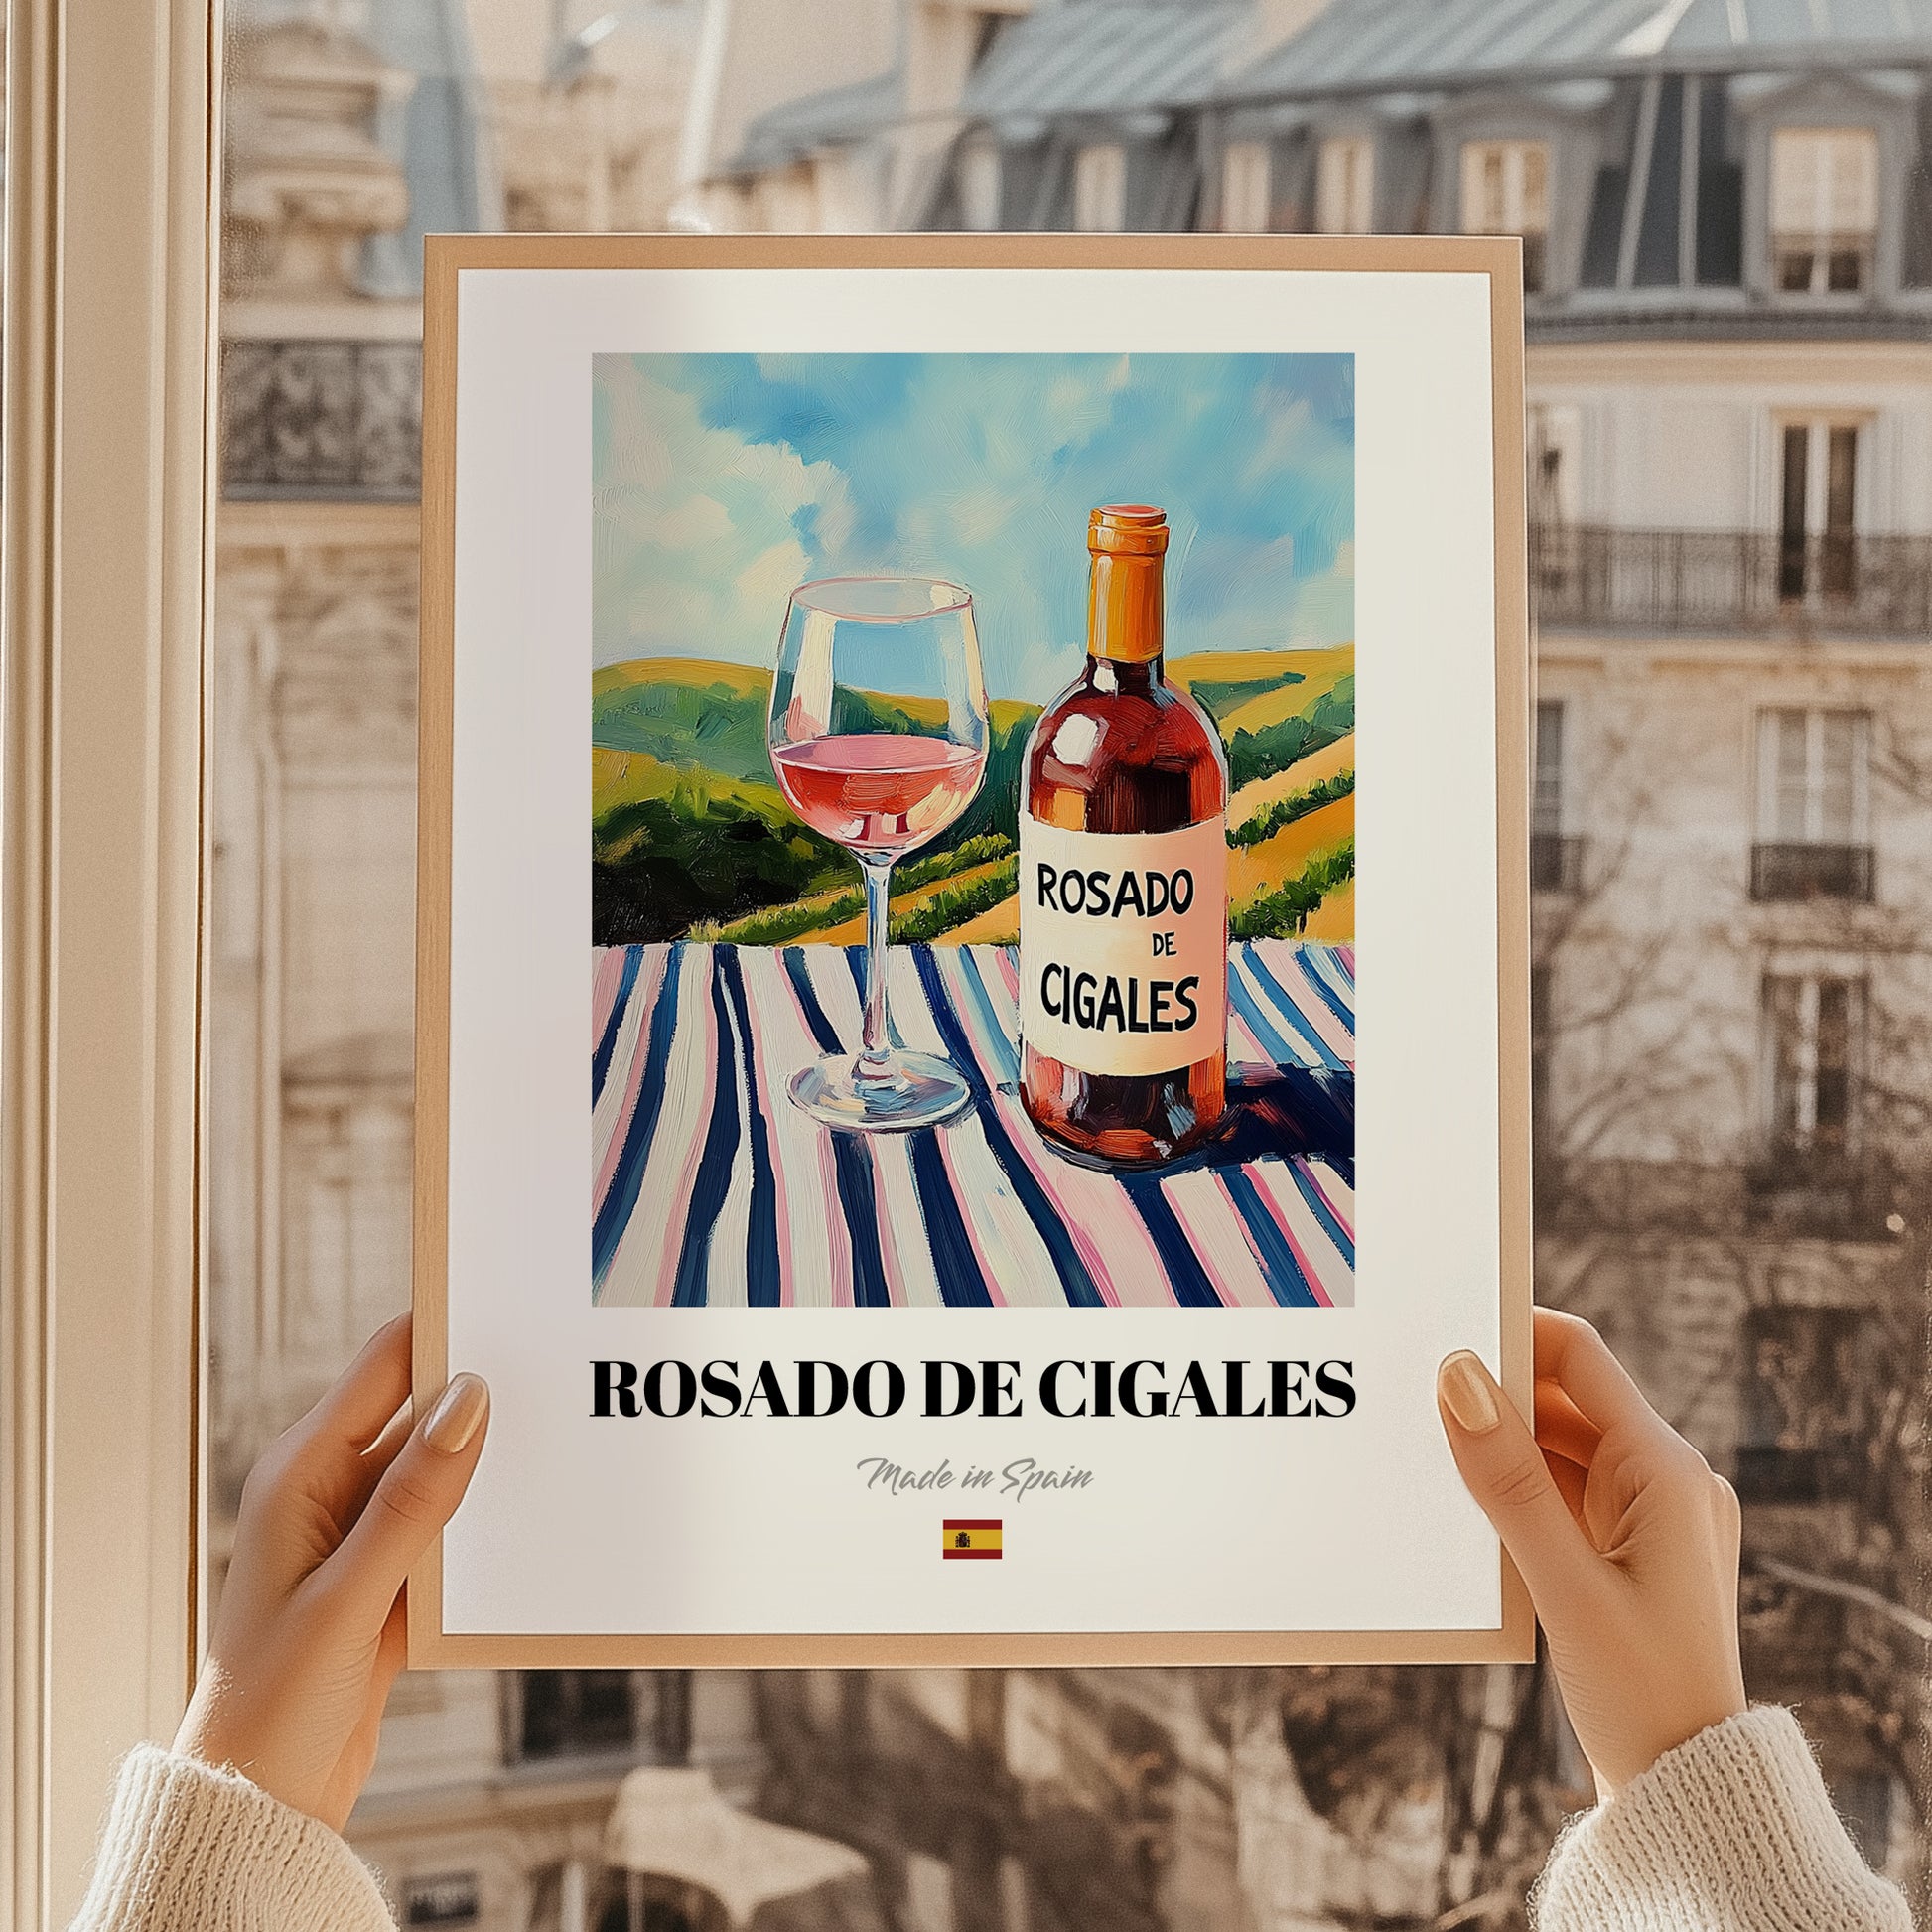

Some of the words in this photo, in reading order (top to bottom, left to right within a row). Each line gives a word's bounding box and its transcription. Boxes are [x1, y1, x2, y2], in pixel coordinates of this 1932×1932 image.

[1037, 863, 1194, 917] ROSADO
[1152, 932, 1177, 956] DE
[1041, 963, 1199, 1033] CIGALES
[590, 1360, 905, 1417] ROSADO
[920, 1361, 1022, 1417] DE
[1039, 1360, 1356, 1417] CIGALES
[856, 1457, 956, 1495] Made
[960, 1465, 995, 1489] in
[1000, 1458, 1094, 1503] Spain
